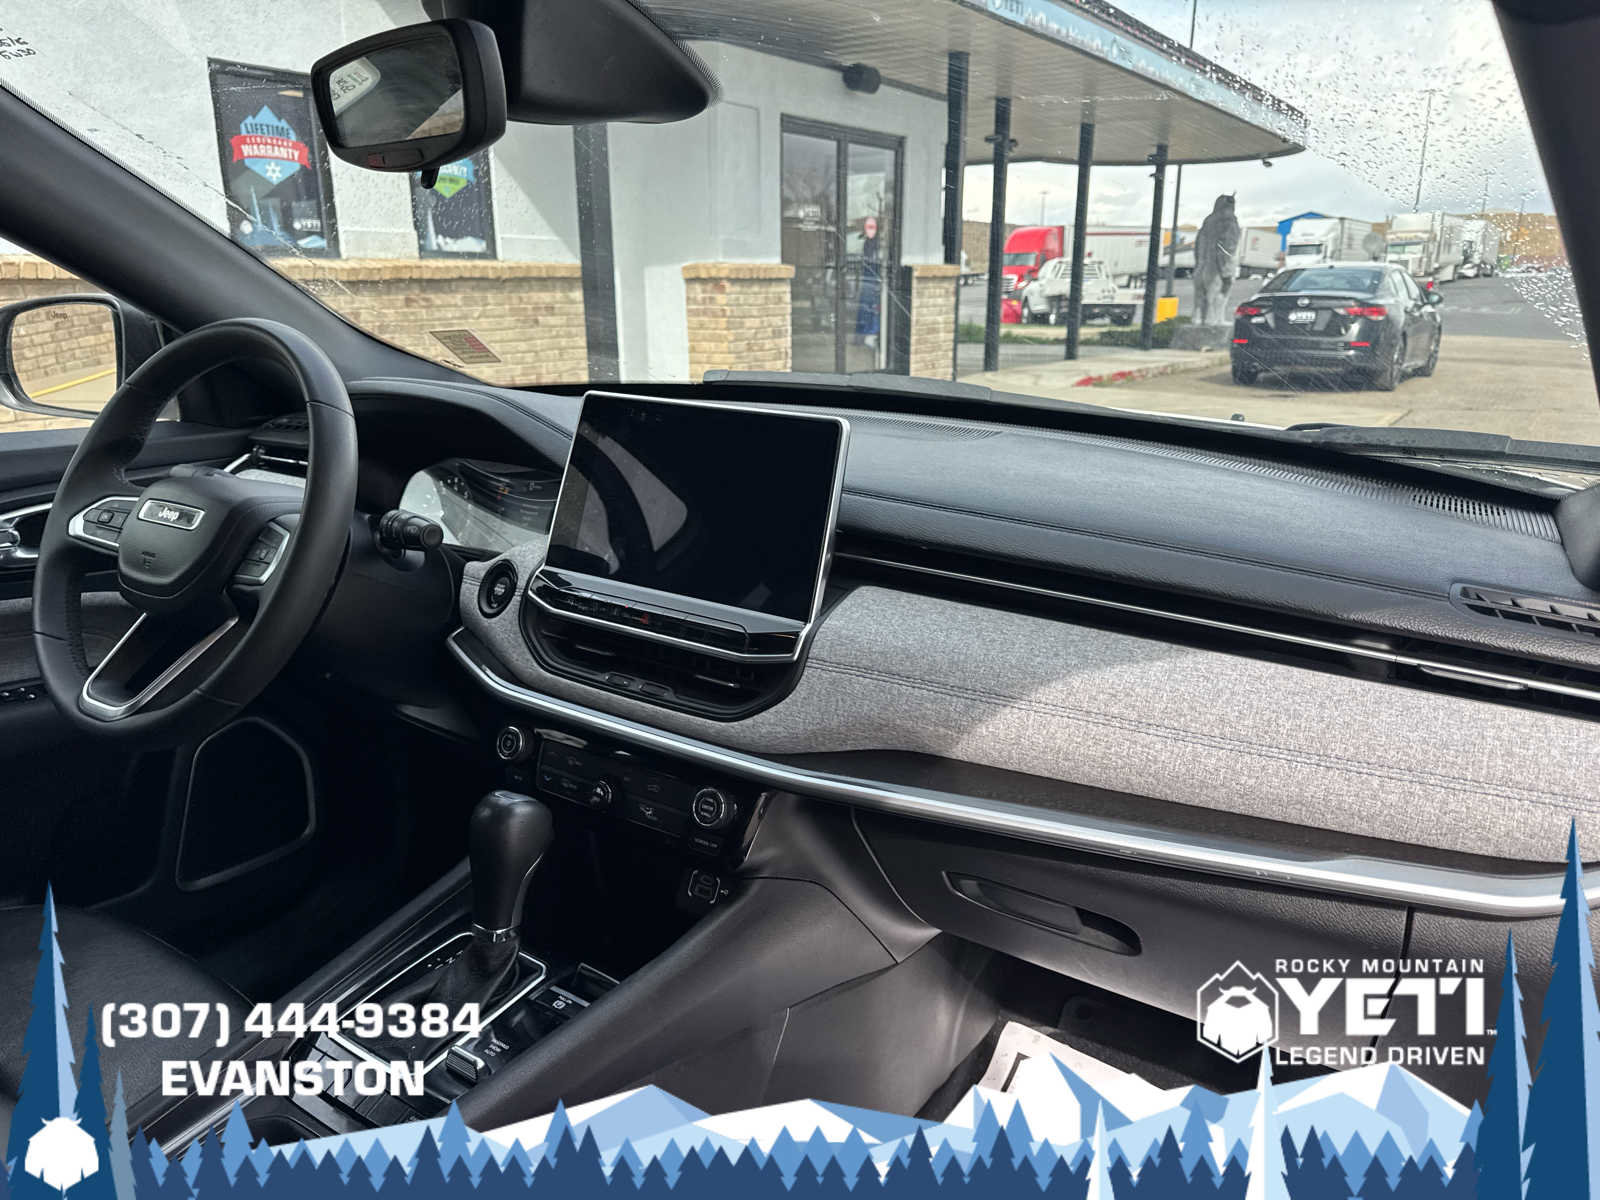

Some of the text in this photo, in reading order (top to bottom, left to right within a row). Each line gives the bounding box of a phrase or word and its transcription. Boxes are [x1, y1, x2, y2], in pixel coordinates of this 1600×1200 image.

[244, 123, 290, 138] LIFETIME
[241, 144, 300, 161] WARRANTY
[158, 507, 180, 521] Jeep
